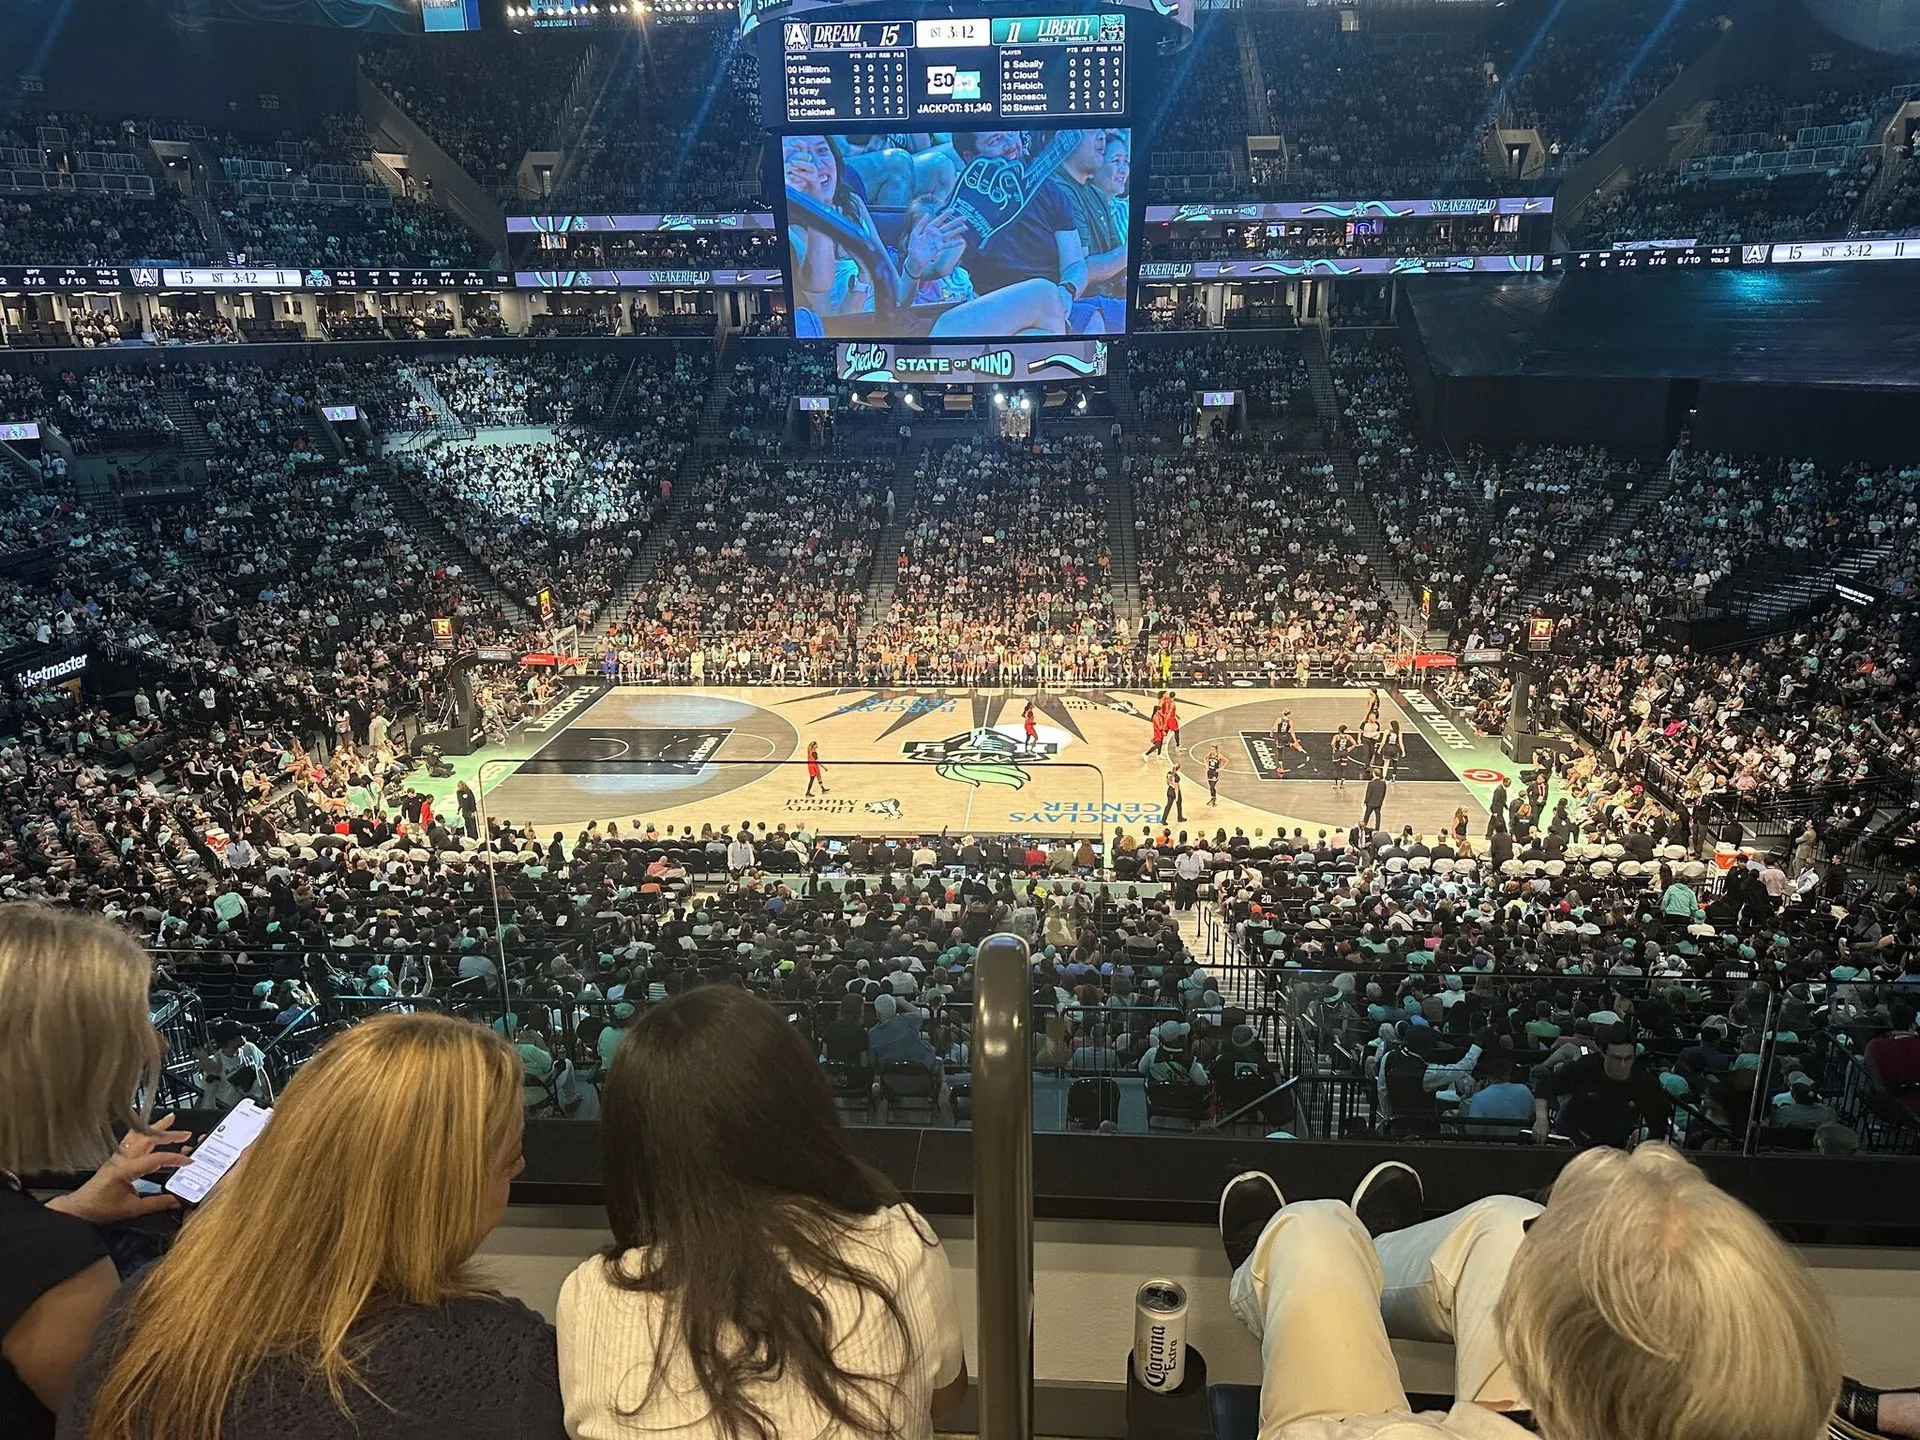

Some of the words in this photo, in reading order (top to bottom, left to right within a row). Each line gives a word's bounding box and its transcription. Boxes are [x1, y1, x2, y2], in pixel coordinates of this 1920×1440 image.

[1005, 21, 1022, 43] 11
[1037, 18, 1094, 37] LIBERTY
[814, 25, 861, 43] DREAM
[879, 24, 900, 47] 15
[798, 65, 830, 74] Hillmon
[867, 64, 874, 72] 0
[883, 64, 888, 72] 1
[1003, 61, 1010, 69] 8
[1013, 60, 1044, 70] Sabally
[1069, 59, 1076, 67] 0
[1084, 58, 1090, 66] 0
[1099, 58, 1105, 66] 3
[853, 75, 860, 83] 2
[868, 75, 874, 83] 2
[896, 74, 903, 82] 0
[1013, 71, 1039, 79] Cloud
[1069, 70, 1076, 78] 0
[1084, 69, 1090, 77] 0
[933, 73, 954, 88] 50
[1084, 80, 1090, 88] 0
[1113, 79, 1119, 87] 0
[789, 87, 798, 95] 15
[800, 87, 820, 97] Gray
[854, 86, 861, 94] 3
[868, 85, 875, 93] 0
[883, 85, 889, 93] 0
[896, 85, 903, 93] 0
[1069, 91, 1076, 99] 2
[1084, 91, 1090, 99] 2
[1099, 90, 1105, 98] 0
[1114, 90, 1119, 98] 1
[788, 98, 798, 106] 24
[800, 98, 826, 106] Jones
[854, 97, 861, 105] 2
[883, 96, 889, 104] 2
[896, 96, 903, 104] 0
[1002, 104, 1012, 112] 30
[1013, 103, 1047, 111] Stewart
[1069, 102, 1076, 110] 4
[1100, 101, 1105, 109] 1
[1112, 101, 1119, 109] 0
[800, 108, 835, 116] Caldwell
[870, 107, 875, 115] 1
[884, 107, 889, 115] 1
[917, 104, 962, 113] JACKPOT:
[964, 102, 992, 114] $1,340
[1430, 200, 1497, 212] SNEAKERHEAD
[1788, 245, 1802, 260] 15
[180, 271, 194, 284] 15
[649, 271, 710, 282] SNEAKERHEAD
[896, 358, 950, 371] STATE
[954, 360, 967, 368] OF
[971, 352, 1012, 376] MIND
[524, 686, 600, 732] LIBERTY
[1398, 688, 1440, 713] NEW
[1422, 714, 1475, 749] YORK
[1042, 801, 1162, 812] CENTER
[1008, 812, 1163, 824] BARCLAYS
[1261, 894, 1271, 903] 20
[1145, 1325, 1166, 1387] Corona
[1164, 1339, 1177, 1371] Extra
